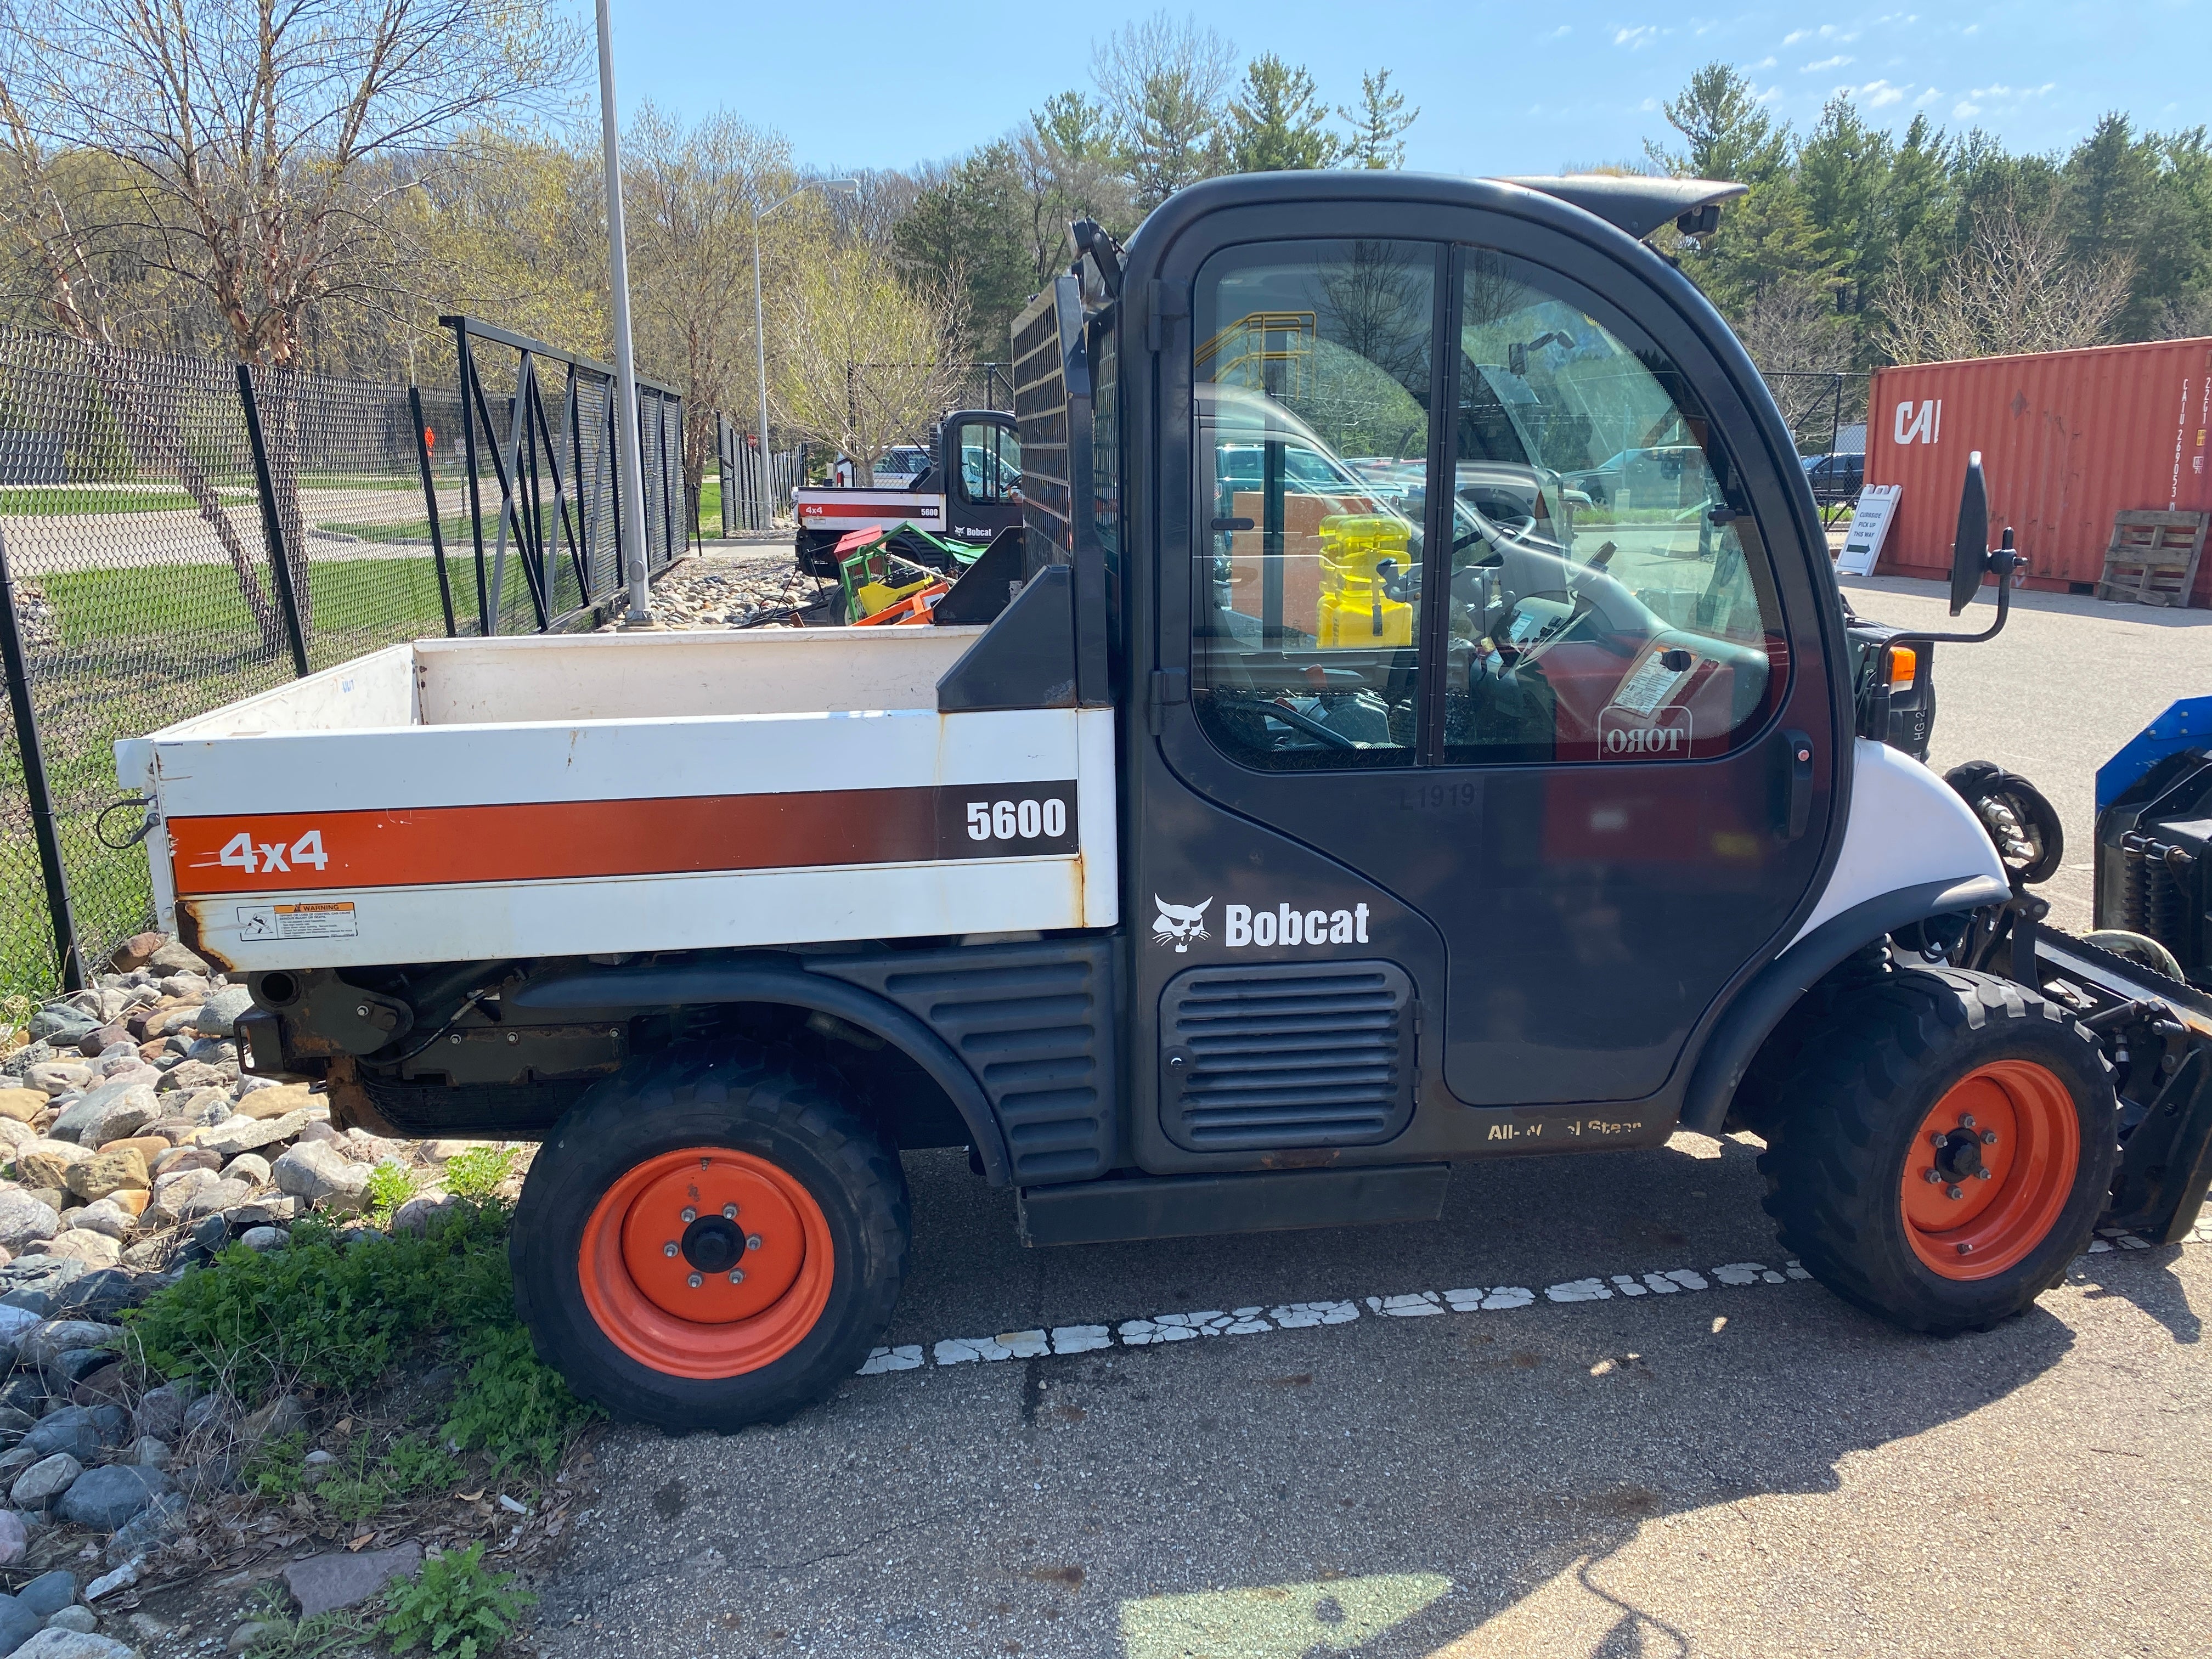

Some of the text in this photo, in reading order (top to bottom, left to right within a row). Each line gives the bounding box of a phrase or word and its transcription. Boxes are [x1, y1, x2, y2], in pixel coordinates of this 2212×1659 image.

[1894, 399, 1942, 444] CAI
[2180, 379, 2188, 425] CAIU
[2171, 429, 2183, 498] 269053
[805, 506, 823, 514] 4x4
[921, 508, 938, 516] 5600
[967, 527, 992, 537] Bobcat
[1400, 783, 1475, 810] L1919
[967, 798, 1066, 840] 5600
[219, 830, 329, 873] 4x4
[1226, 902, 1369, 947] Bobcat
